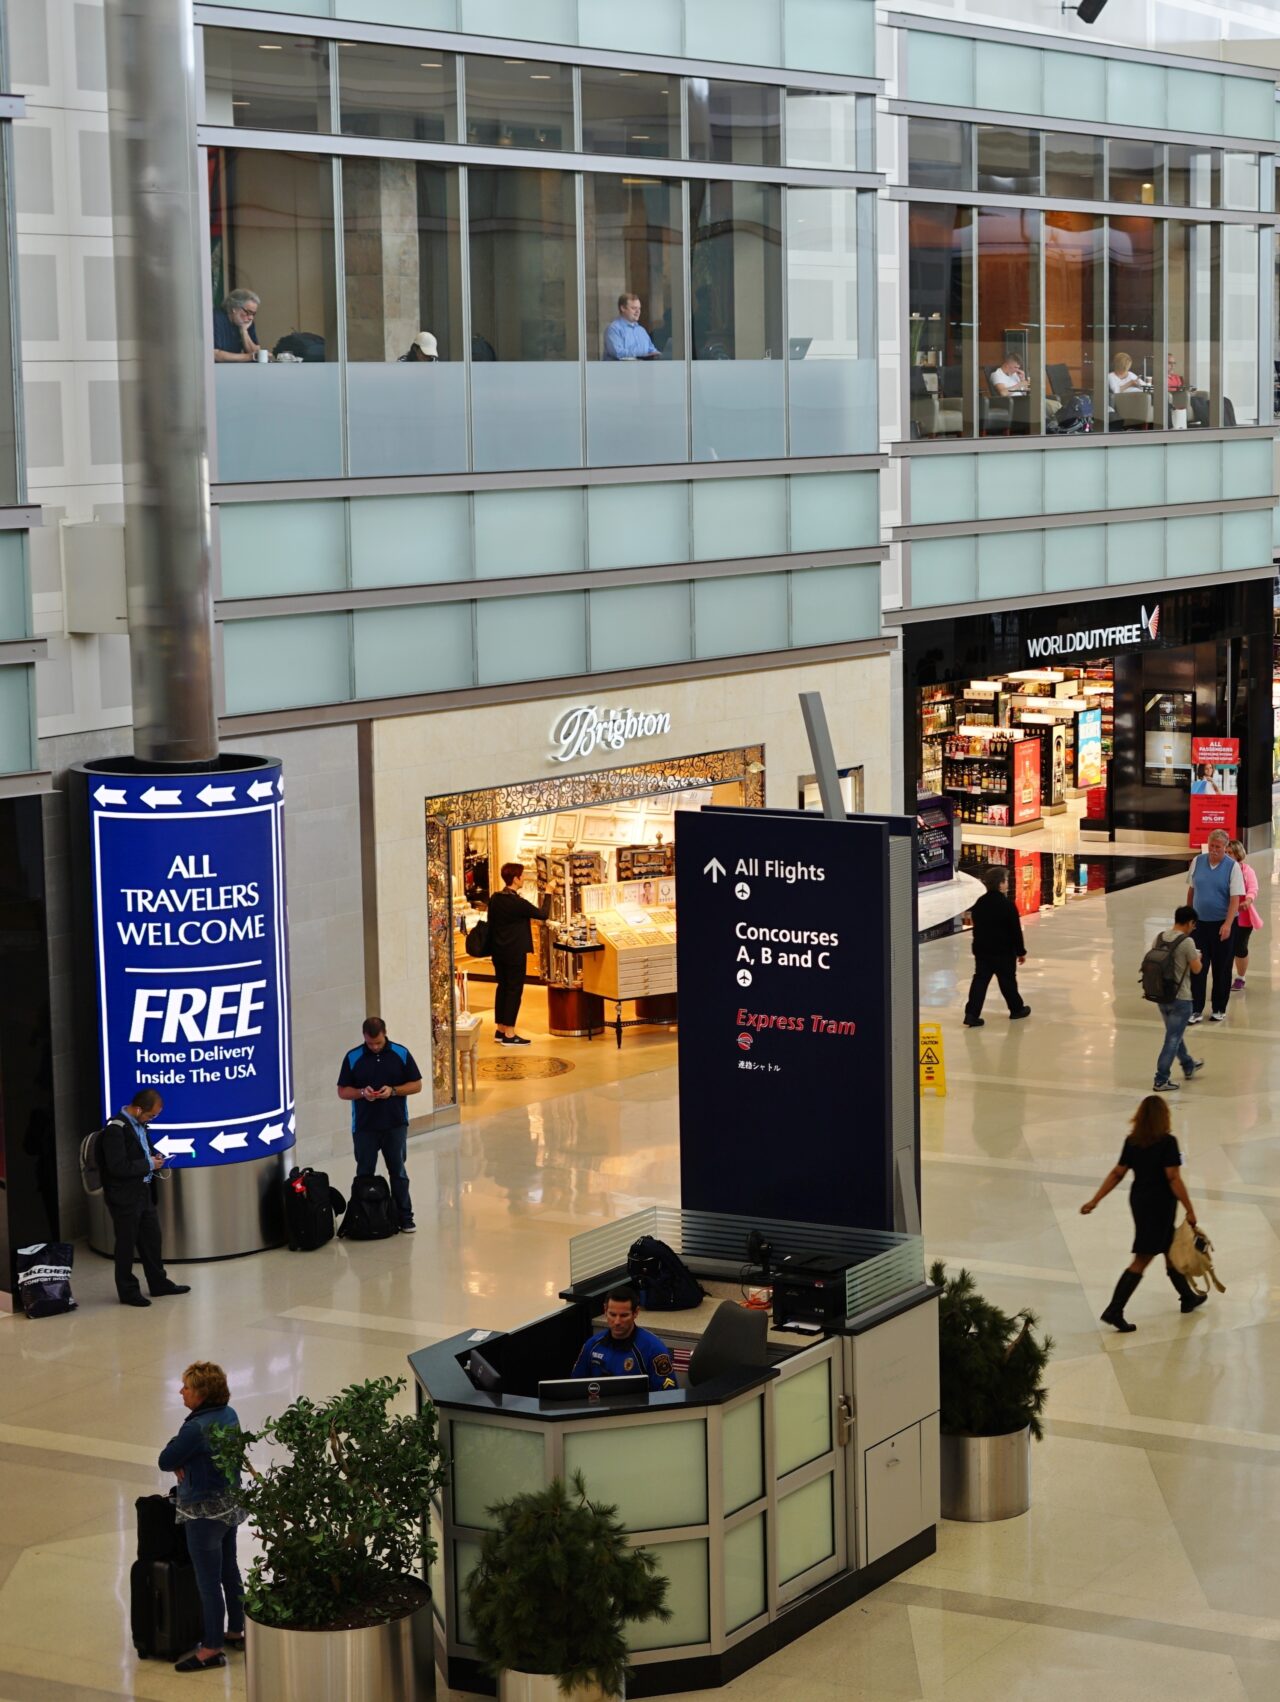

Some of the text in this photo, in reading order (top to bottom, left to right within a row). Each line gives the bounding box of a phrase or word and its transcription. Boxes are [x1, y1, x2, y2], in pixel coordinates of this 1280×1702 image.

[1027, 623, 1141, 658] WORLDDUTYFREE
[551, 705, 671, 762] Brighton
[167, 854, 217, 879] ALL
[734, 858, 826, 884] All Flights
[120, 882, 260, 913] TRAVELERS
[117, 914, 265, 946] WELCOME
[735, 922, 839, 946] Concourses
[736, 946, 830, 969] A, B and C
[128, 979, 266, 1043] FREE
[736, 1008, 856, 1036] Express Tram
[136, 1045, 254, 1064] Home Delivery
[136, 1063, 256, 1084] Inside The USA
